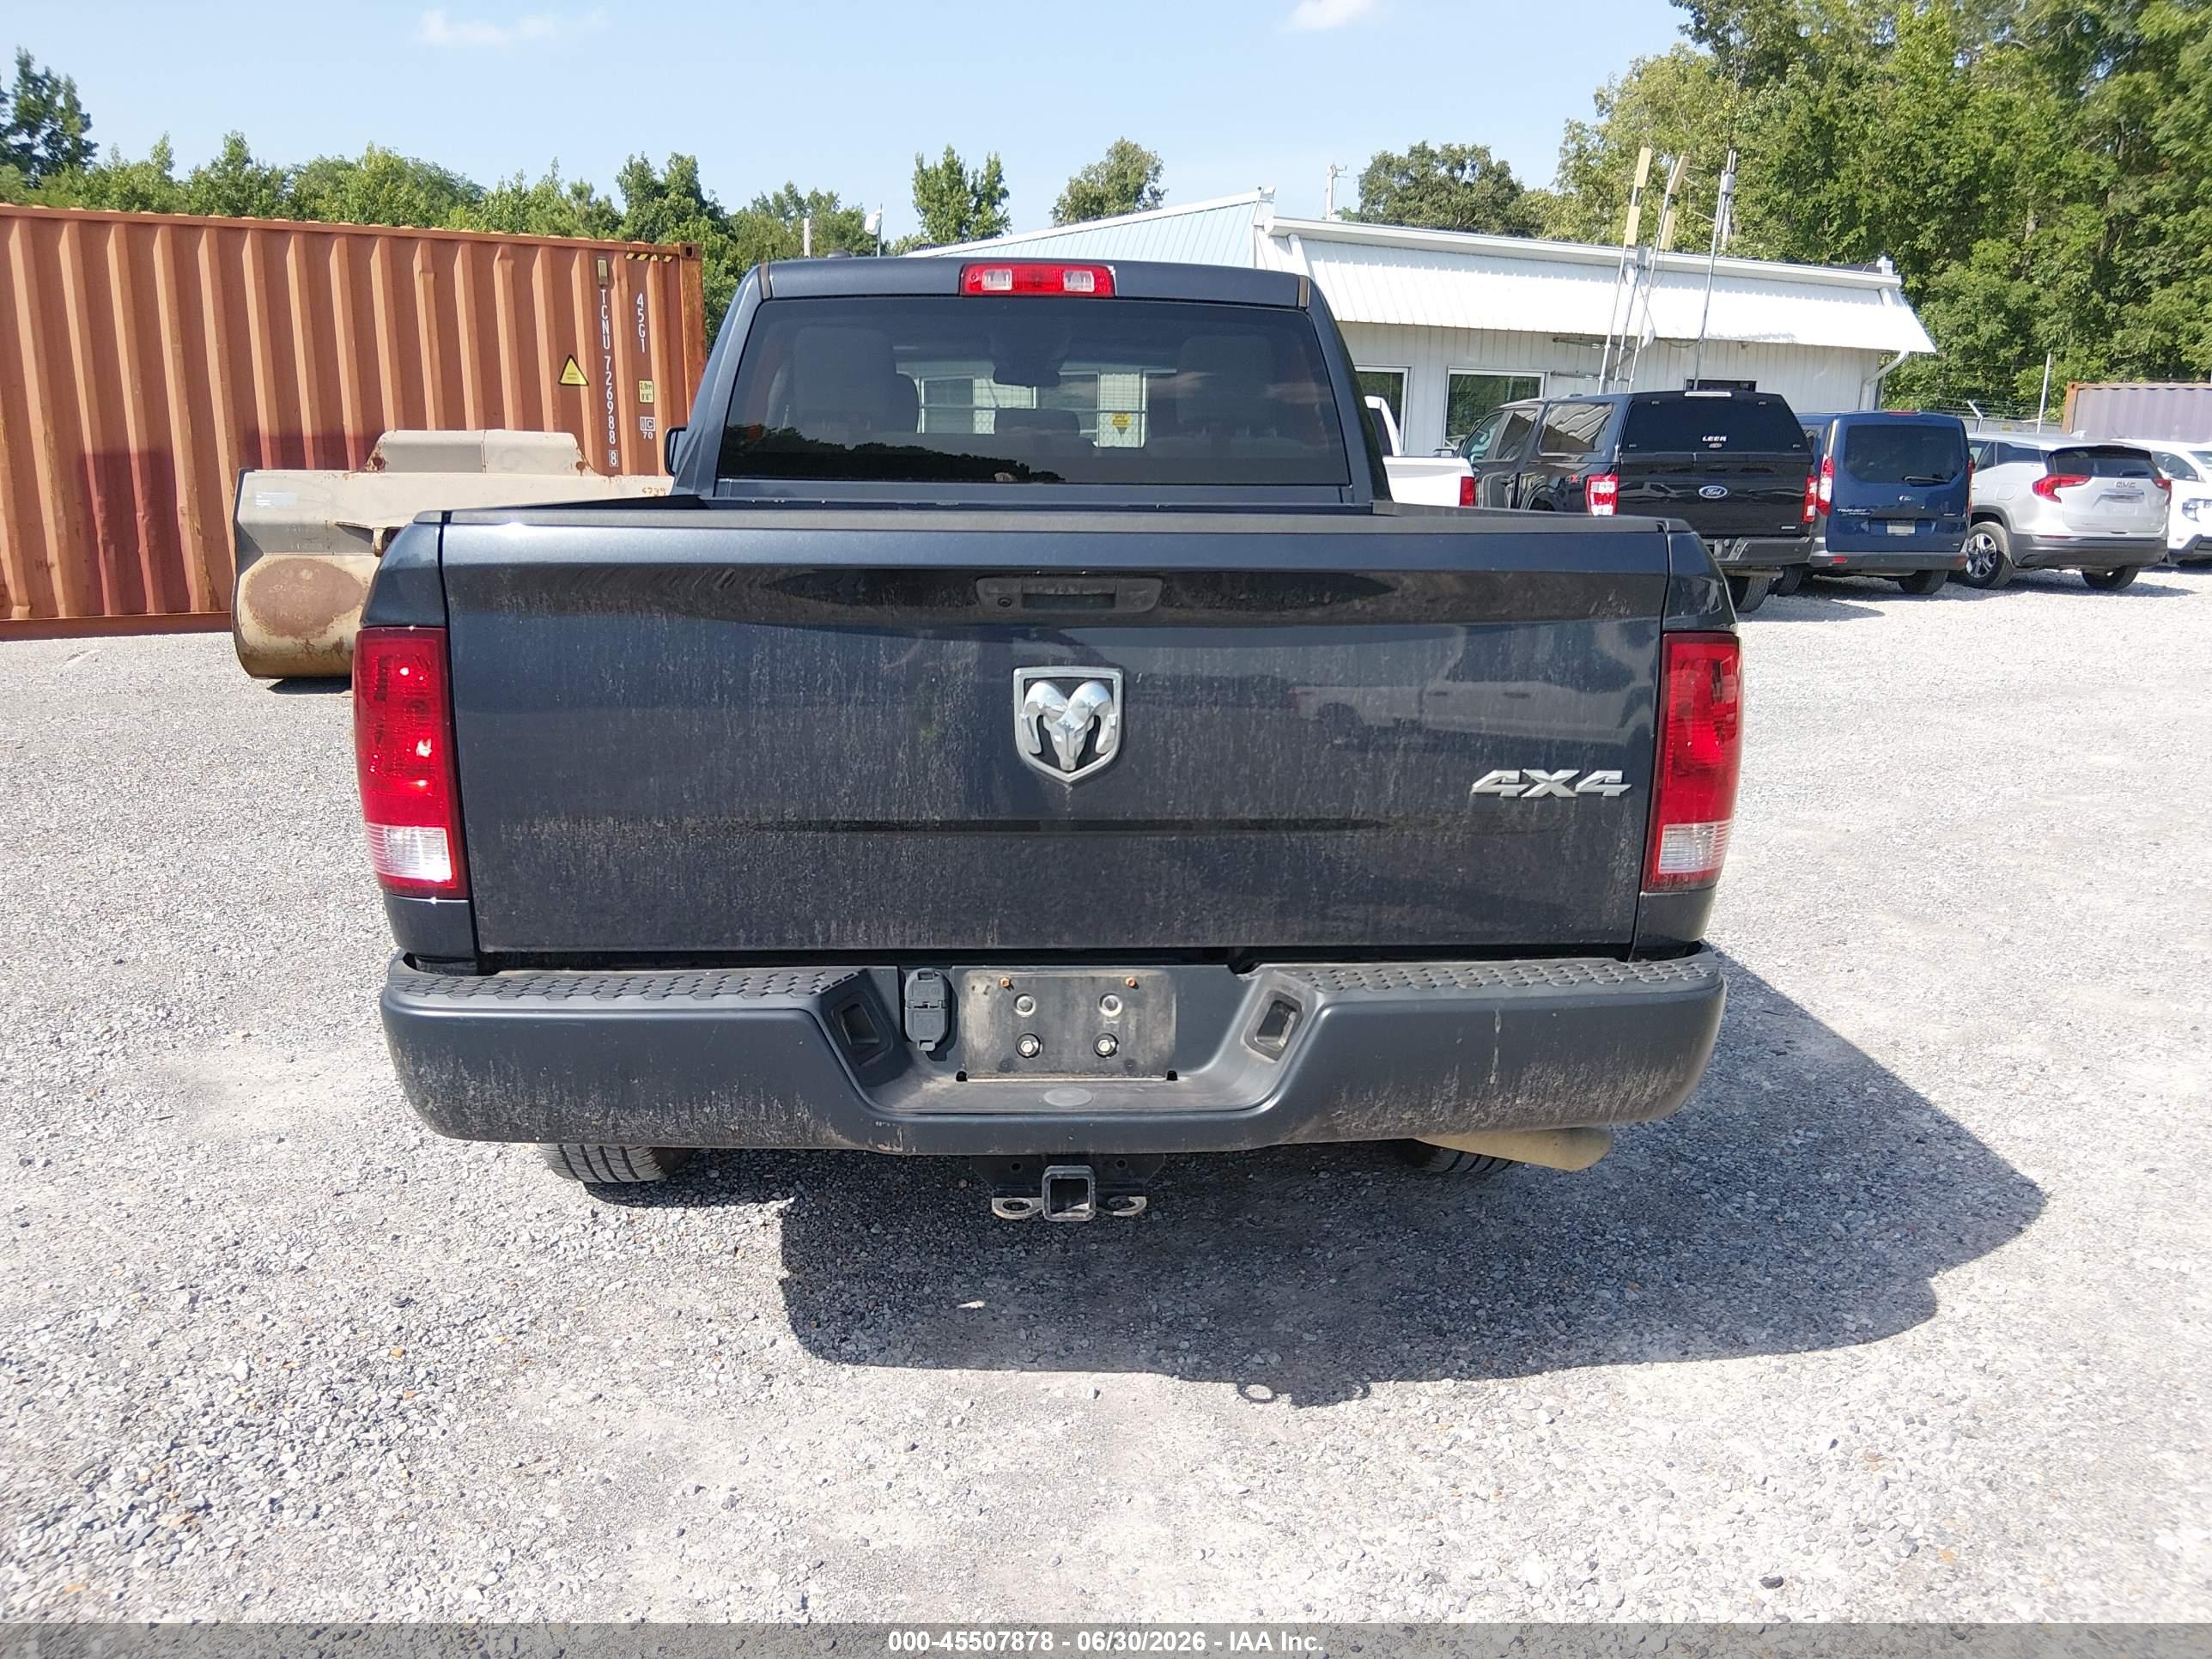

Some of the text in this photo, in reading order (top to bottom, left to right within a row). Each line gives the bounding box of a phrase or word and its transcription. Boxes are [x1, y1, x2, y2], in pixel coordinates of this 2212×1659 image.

[636, 293, 646, 353] 45G1
[600, 289, 617, 466] TCNU 726988 8
[642, 431, 653, 440] 70
